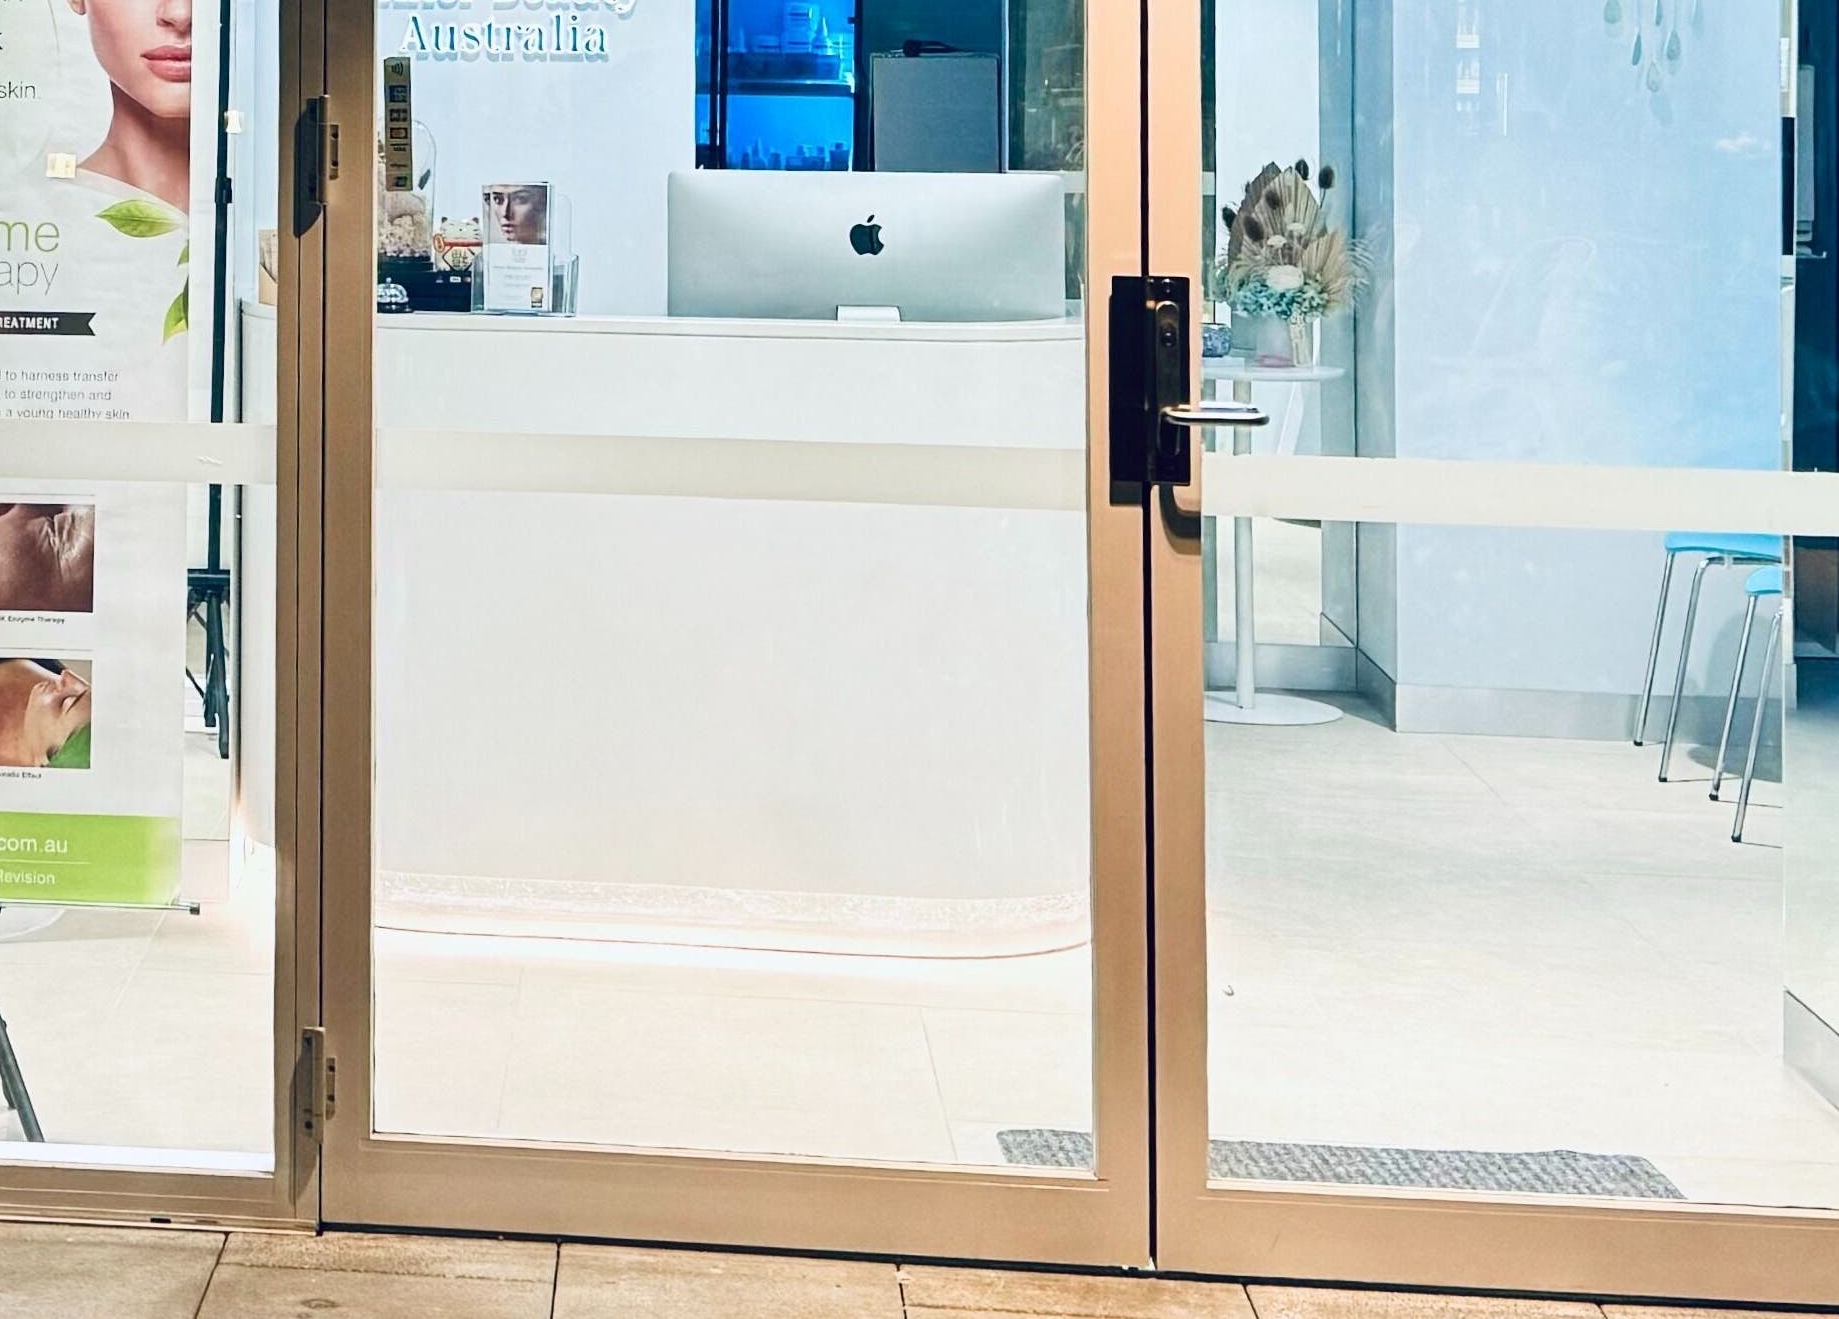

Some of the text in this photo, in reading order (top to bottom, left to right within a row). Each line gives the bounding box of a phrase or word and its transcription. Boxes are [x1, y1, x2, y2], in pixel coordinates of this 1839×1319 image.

[400, 13, 610, 54] Australia
[5, 369, 17, 381] to
[21, 370, 70, 382] harness
[73, 370, 119, 382] transfer
[4, 388, 16, 399] to
[20, 388, 86, 402] strengthen
[88, 389, 112, 401] and
[5, 408, 13, 417] a
[16, 408, 54, 420] young
[58, 407, 102, 420] healthy
[105, 408, 131, 420] skin
